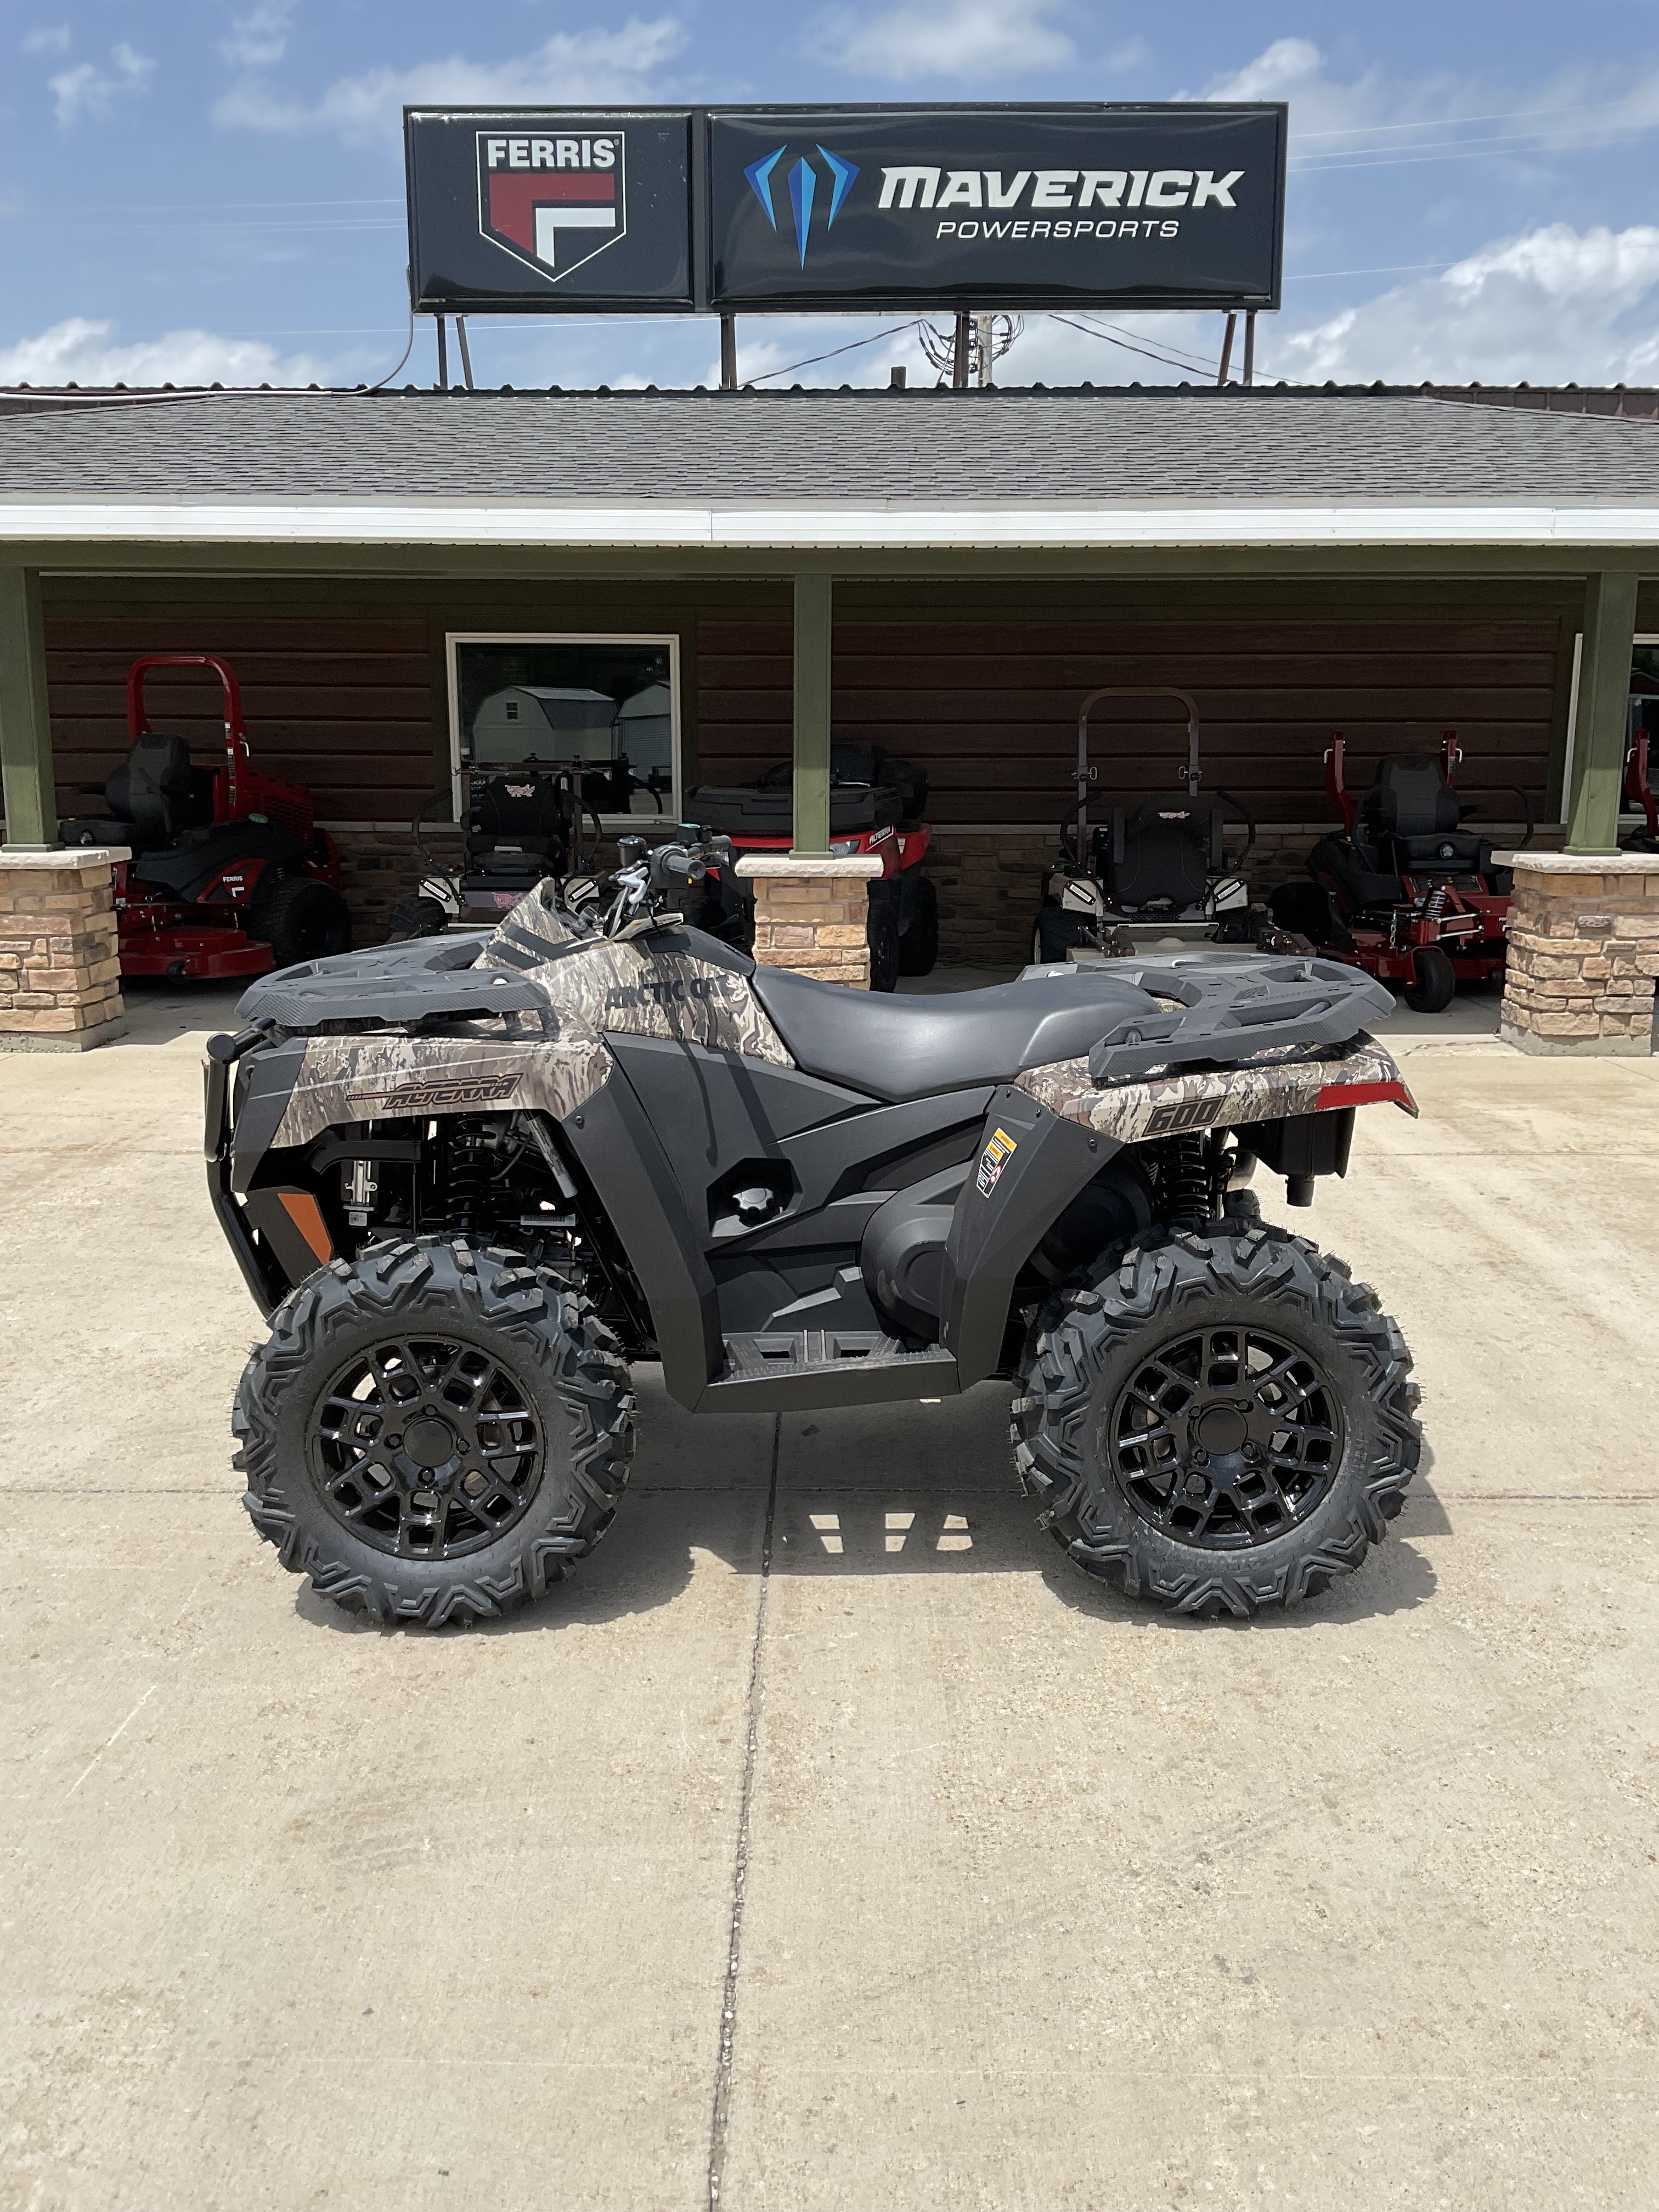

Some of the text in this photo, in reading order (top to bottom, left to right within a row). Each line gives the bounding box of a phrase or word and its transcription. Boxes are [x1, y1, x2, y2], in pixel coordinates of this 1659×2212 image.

[488, 138, 616, 168] FERRIS
[878, 166, 1245, 208] MAVERICK
[936, 220, 1180, 239] POWERSPORTS
[605, 980, 685, 1011] ARCTIC
[1147, 1098, 1223, 1133] 600
